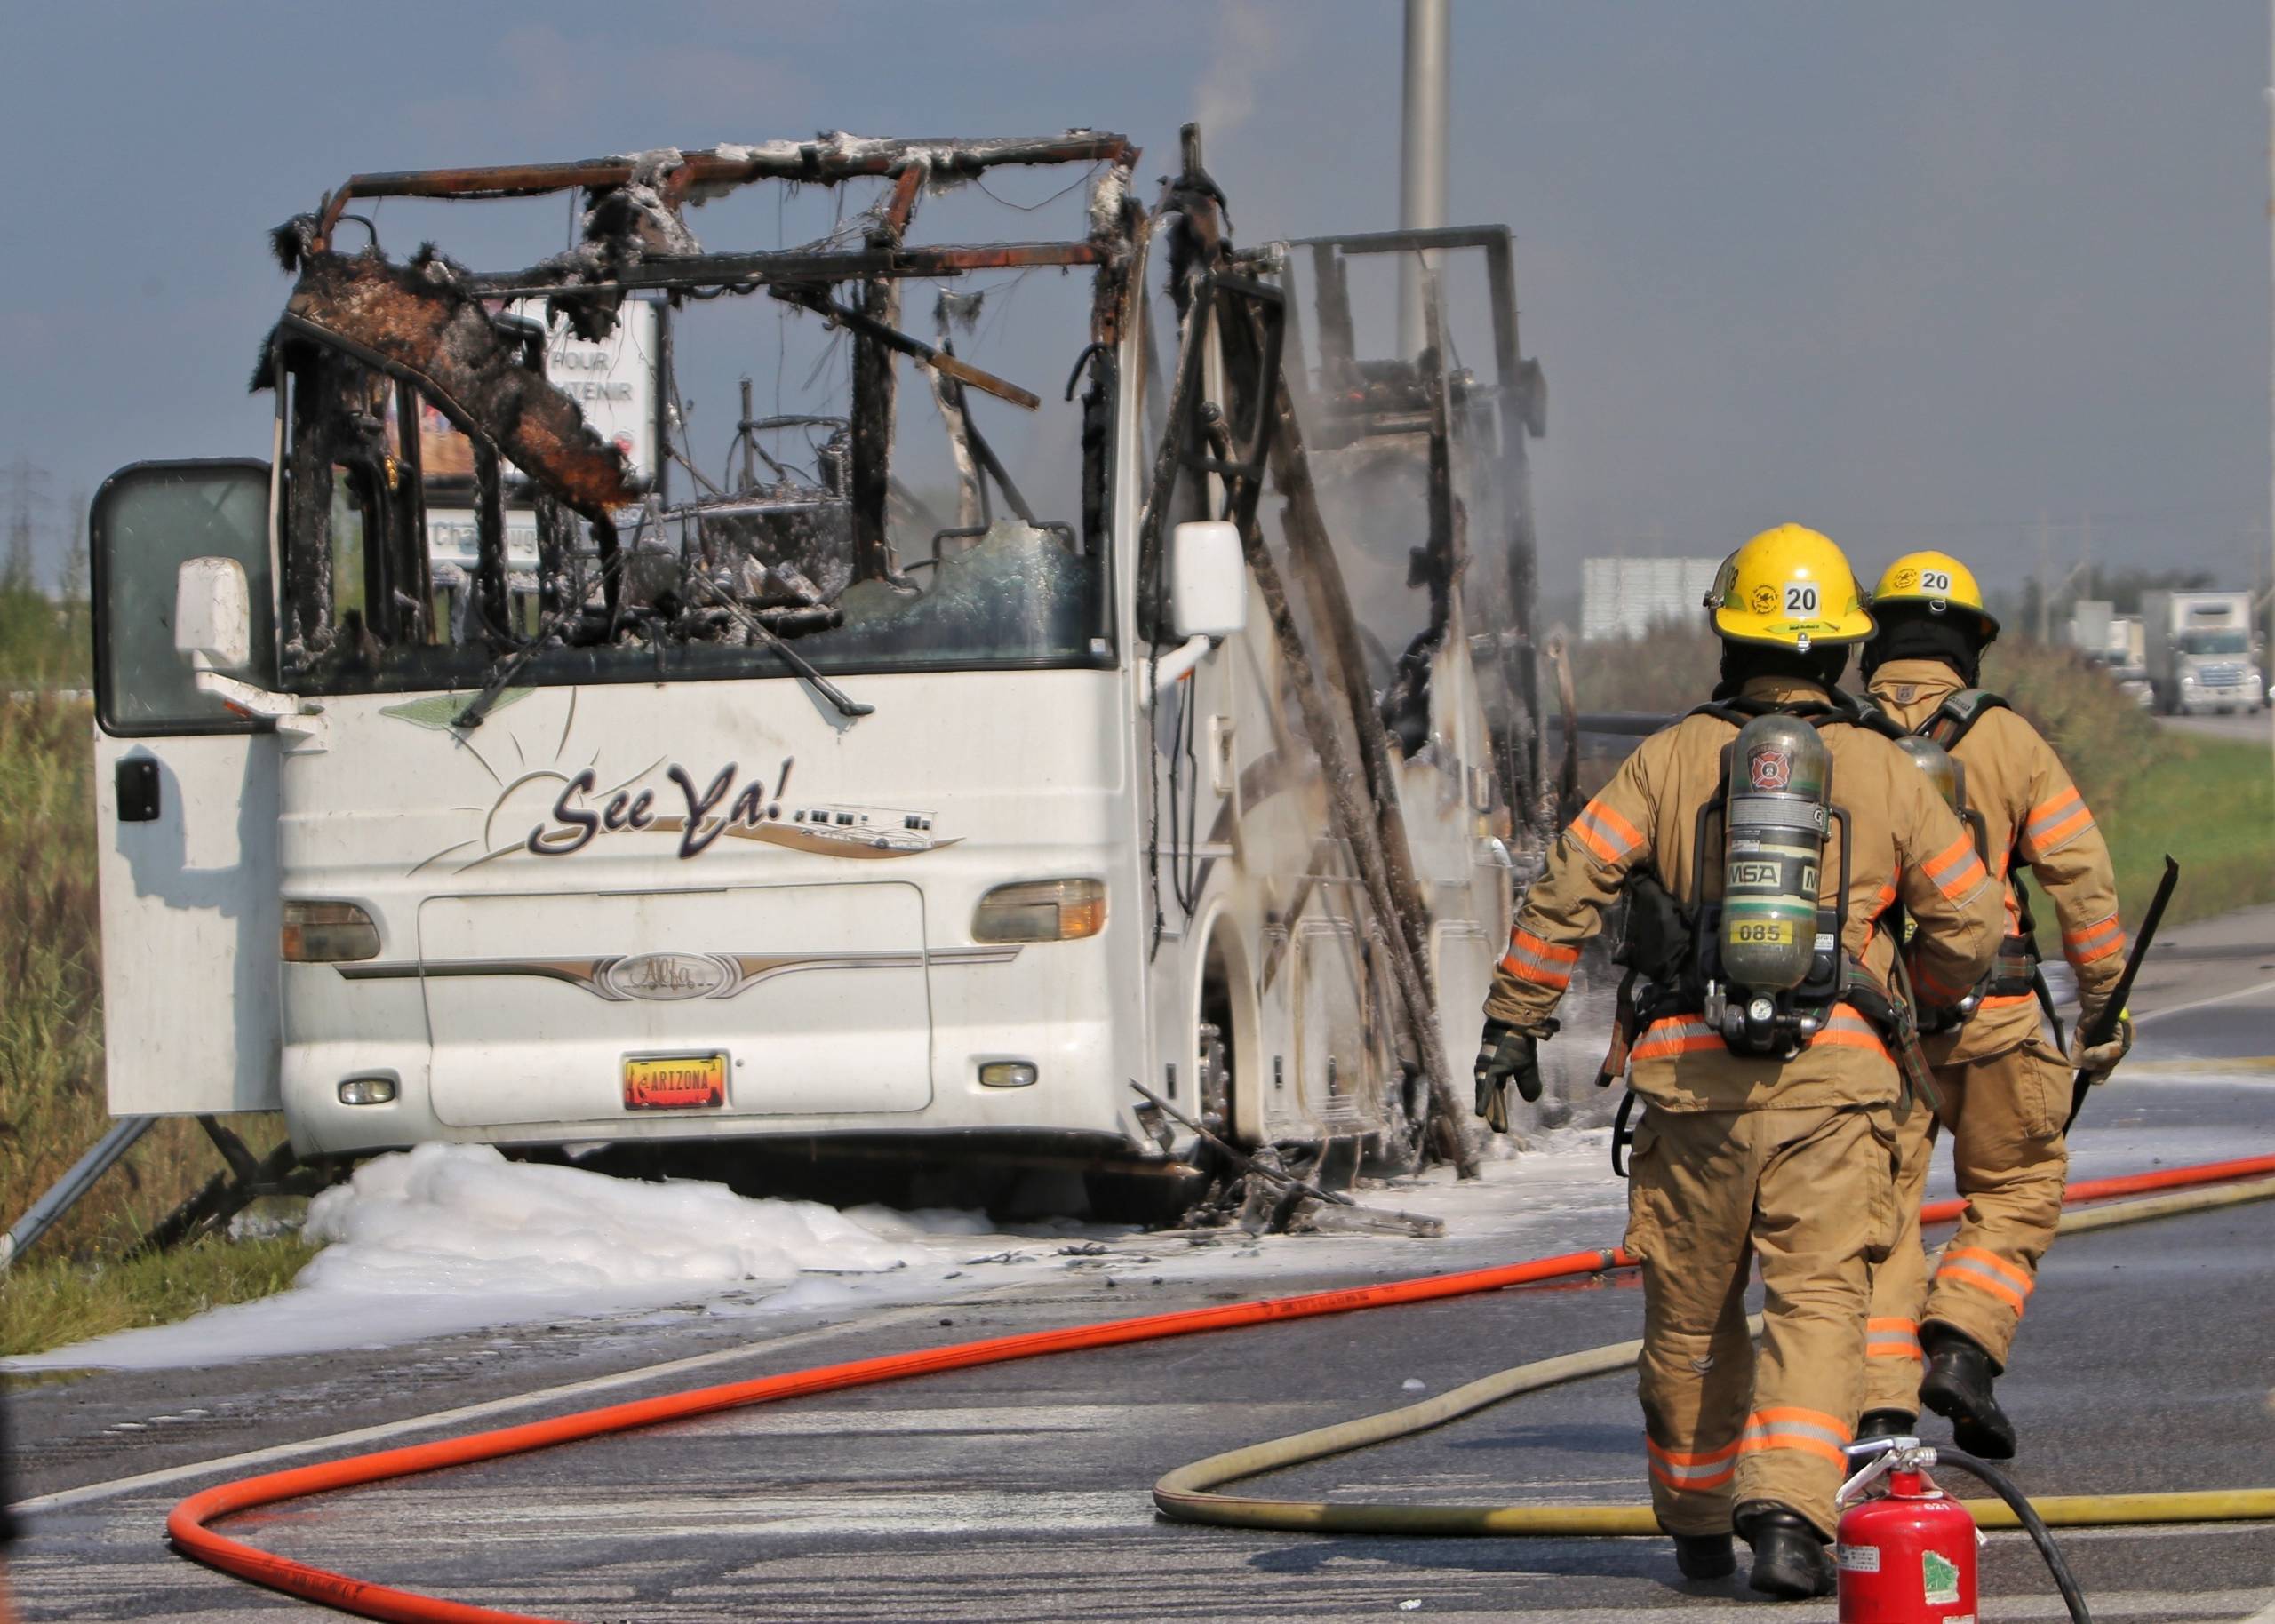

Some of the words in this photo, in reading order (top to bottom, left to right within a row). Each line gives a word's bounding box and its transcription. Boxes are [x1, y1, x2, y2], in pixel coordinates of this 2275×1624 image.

[562, 380, 633, 400] TENIR
[1923, 572, 1948, 590] 20
[1787, 588, 1816, 610] 20
[526, 768, 654, 855] See
[667, 755, 794, 859] Ya!
[1728, 865, 1777, 883] MSA
[1740, 925, 1780, 941] 085
[651, 1070, 708, 1091] ARIZONA
